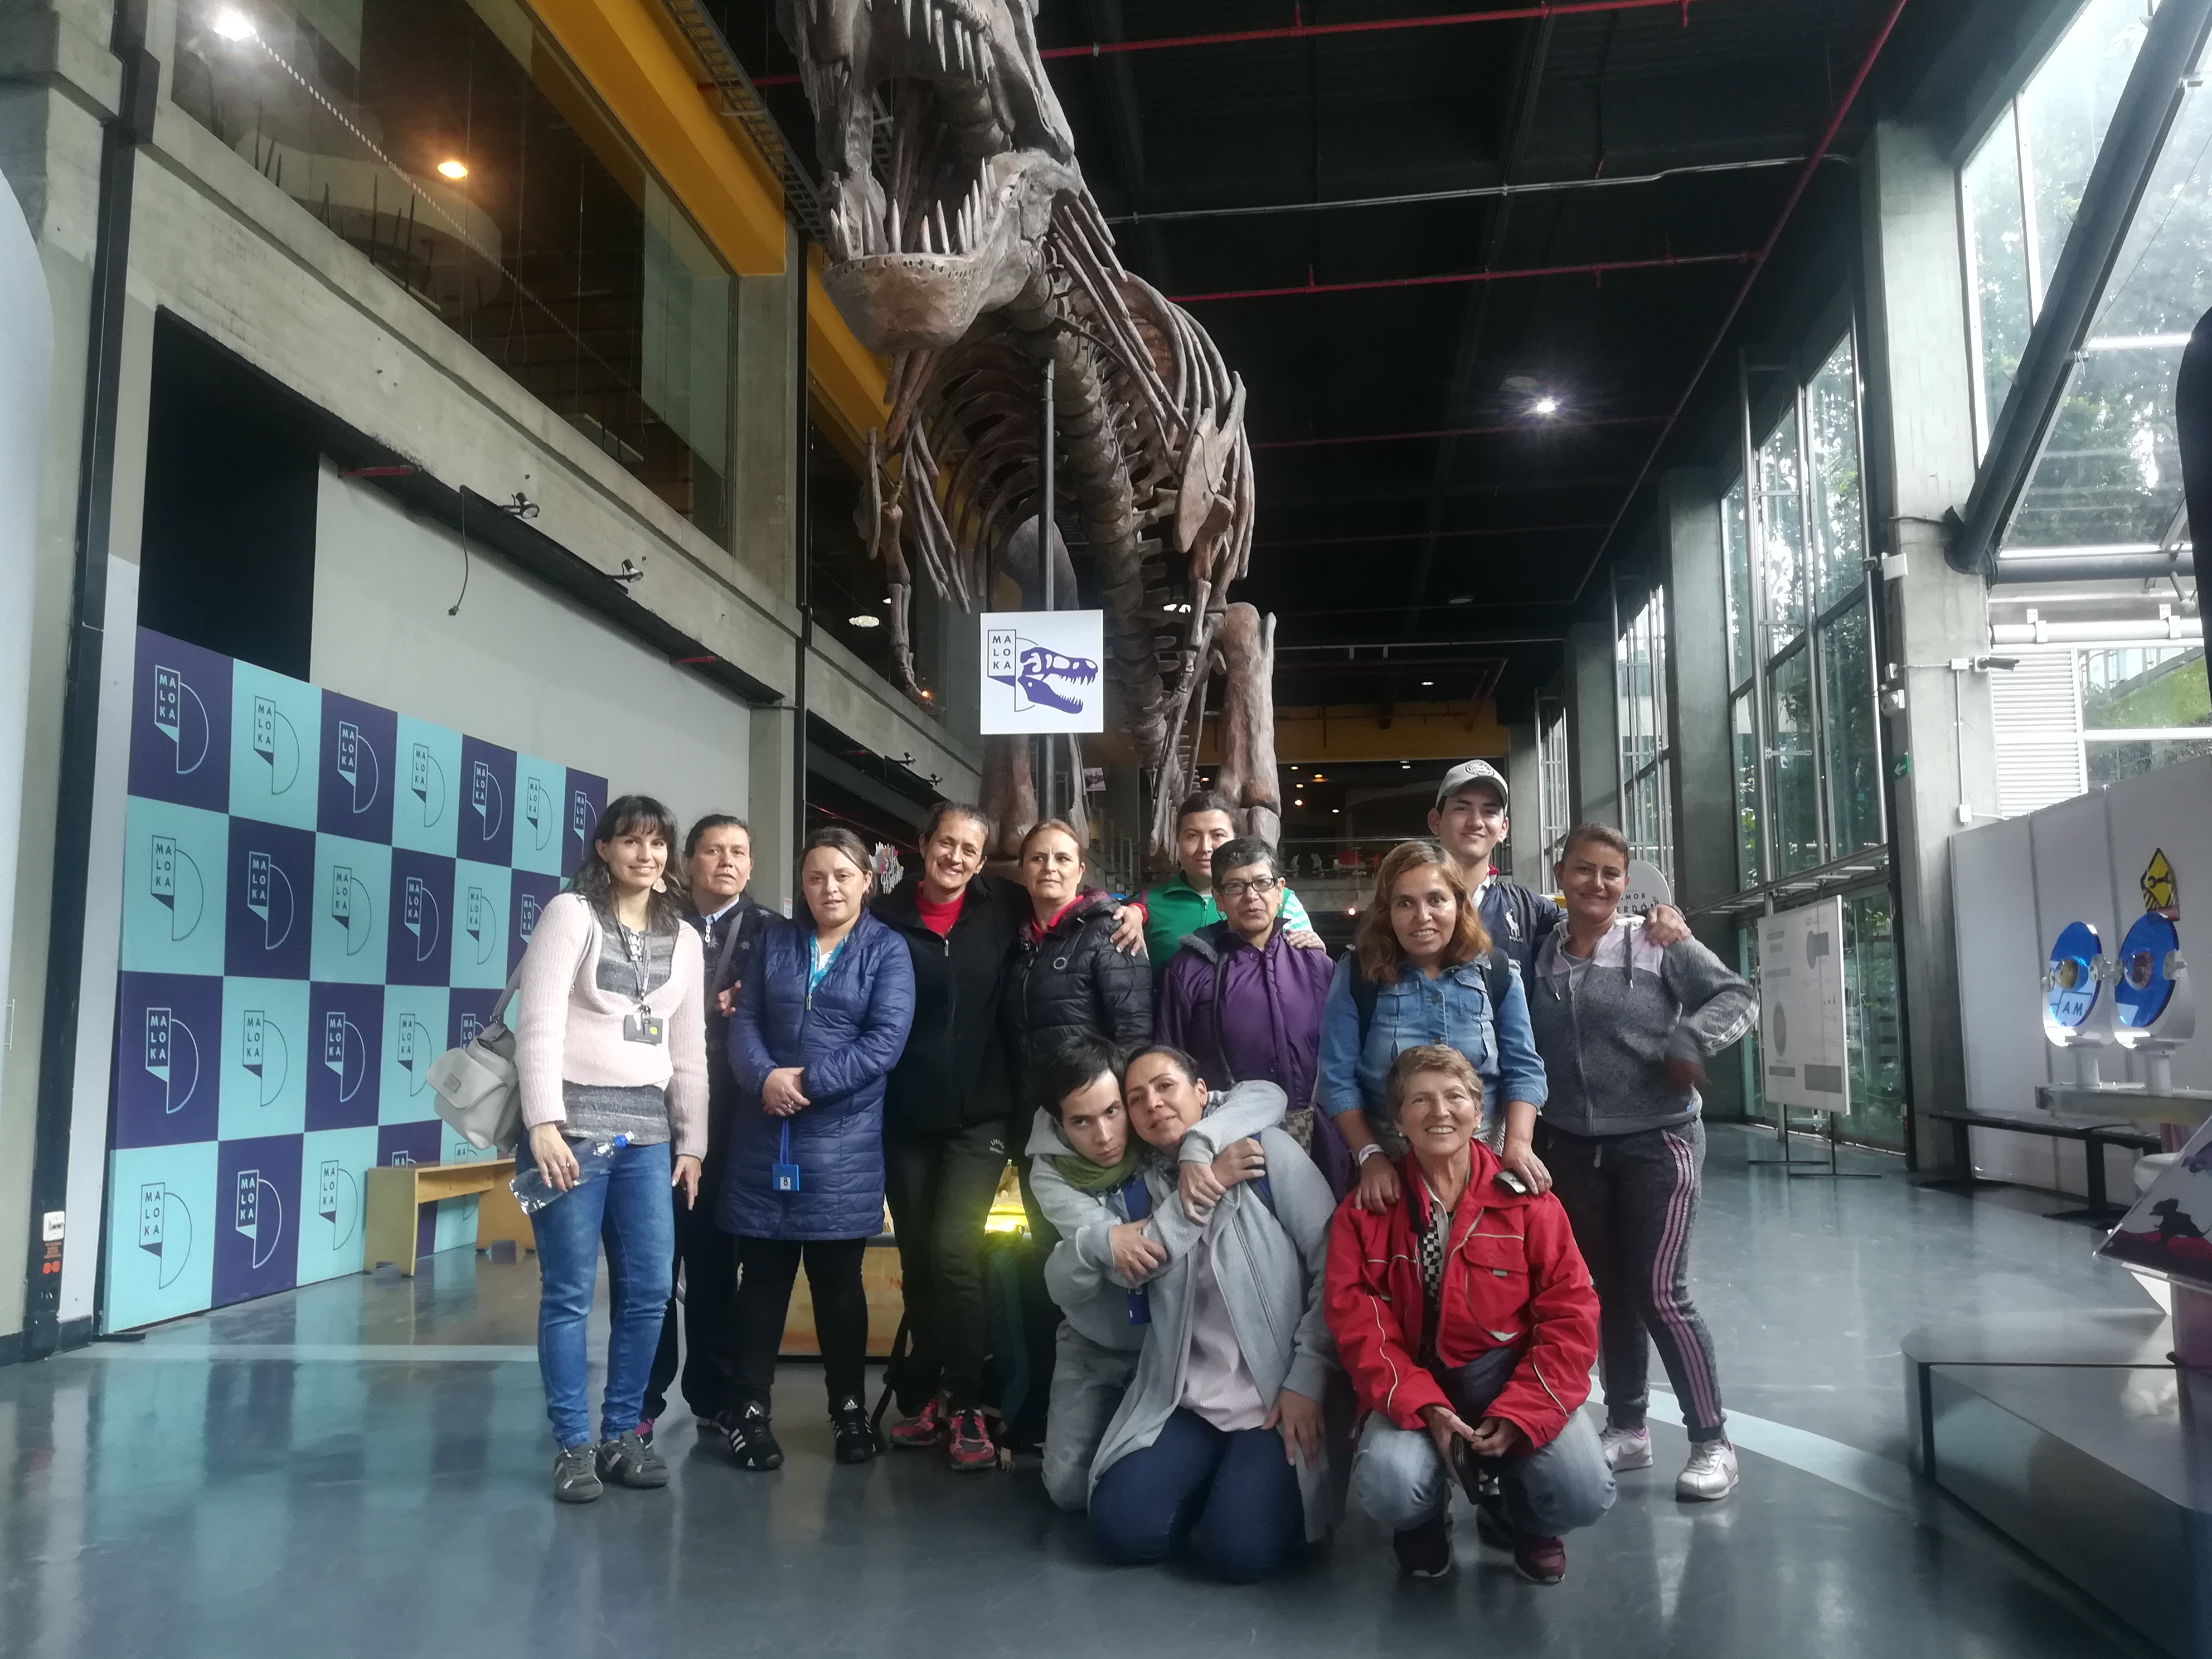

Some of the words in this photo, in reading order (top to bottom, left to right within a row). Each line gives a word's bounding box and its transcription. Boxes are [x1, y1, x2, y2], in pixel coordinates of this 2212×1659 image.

[992, 636, 1011, 644] MA
[993, 648, 1011, 657] LO
[993, 661, 1011, 670] KA
[159, 674, 176, 688] MA
[160, 690, 176, 704] LO
[159, 706, 176, 720] KA
[258, 704, 272, 717] MA
[258, 718, 271, 730] LO
[258, 733, 271, 745] KA
[342, 728, 355, 741] MA
[342, 742, 354, 753] LO
[415, 749, 426, 760] MA
[342, 755, 354, 767] KA
[415, 762, 425, 772] LO
[476, 767, 486, 777] MA
[415, 775, 425, 785] KA
[476, 779, 485, 789] LO
[530, 783, 538, 792] MA
[476, 790, 484, 801] KA
[529, 794, 537, 803] LO
[577, 796, 584, 804] MA
[529, 804, 537, 813] KA
[576, 806, 584, 816] LO
[576, 817, 584, 826] KA
[156, 843, 172, 856] MA
[156, 859, 171, 871] LO
[252, 858, 267, 871] MA
[156, 875, 171, 887] KA
[253, 874, 266, 885] LO
[336, 872, 348, 882] MA
[336, 886, 348, 896] LO
[409, 883, 420, 894] MA
[252, 889, 266, 900] KA
[470, 892, 479, 901] MA
[1621, 892, 1646, 901] MOR
[335, 900, 347, 910] KA
[409, 896, 419, 906] LO
[523, 899, 532, 909] MA
[408, 909, 418, 918] KA
[470, 904, 479, 913] LO
[469, 916, 478, 925] KA
[523, 911, 532, 920] LO
[523, 922, 531, 930] KA
[151, 1015, 167, 1027] MA
[247, 1017, 261, 1027] MA
[329, 1018, 342, 1028] MA
[401, 1020, 413, 1028] MA
[463, 1019, 473, 1027] MA
[151, 1031, 166, 1043] LO
[247, 1032, 260, 1042] LO
[329, 1032, 341, 1042] LO
[401, 1032, 412, 1041] LO
[463, 1031, 473, 1040] LO
[150, 1047, 166, 1060] KA
[246, 1047, 260, 1057] KA
[329, 1046, 341, 1056] KA
[401, 1045, 411, 1054] KA
[456, 1148, 466, 1157] MA
[395, 1157, 405, 1167] MA
[323, 1167, 336, 1177] MA
[240, 1177, 255, 1190] MA
[323, 1181, 335, 1191] LO
[144, 1191, 161, 1203] MA
[241, 1192, 254, 1205] LO
[323, 1195, 334, 1205] KA
[145, 1207, 160, 1220] LO
[240, 1208, 254, 1220] KA
[144, 1224, 159, 1236] KA
